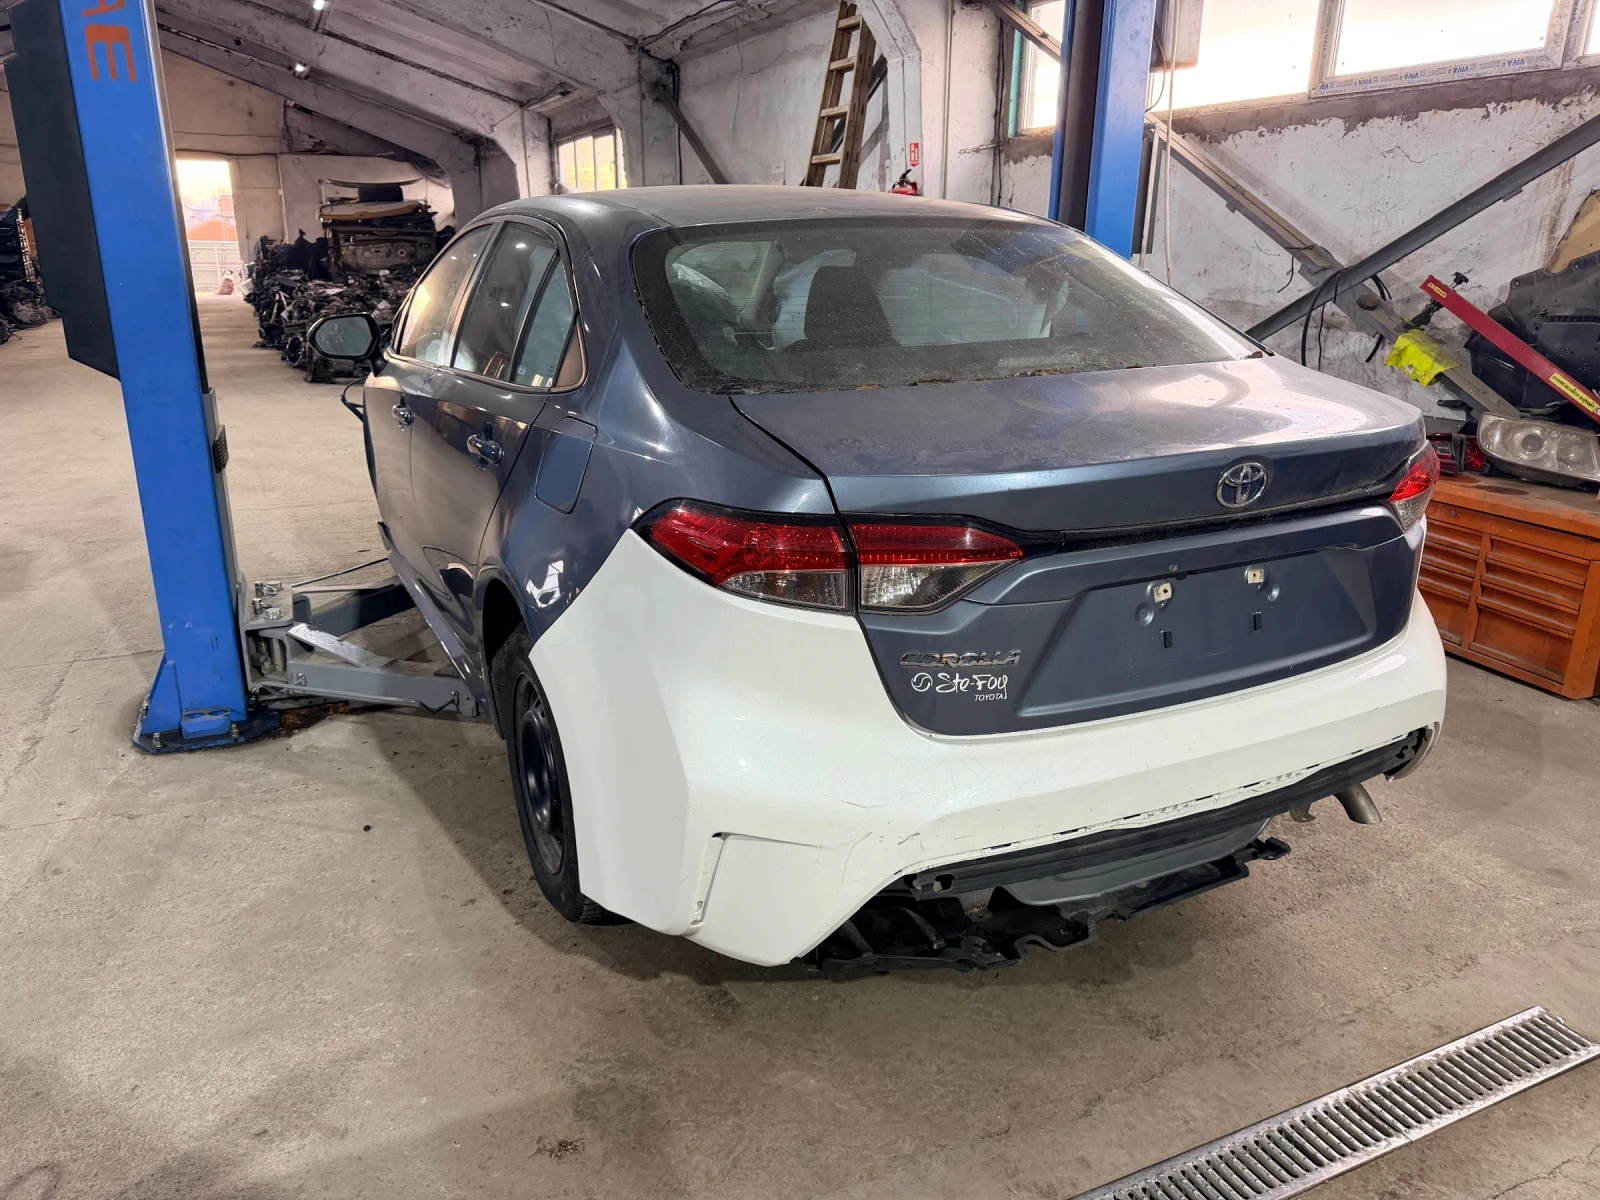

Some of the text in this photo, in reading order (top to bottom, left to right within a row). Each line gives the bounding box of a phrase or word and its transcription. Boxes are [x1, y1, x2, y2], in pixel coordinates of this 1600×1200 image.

[1507, 58, 1525, 66] VIVA
[1453, 65, 1469, 74] VIVA
[1404, 72, 1419, 80] VIVA
[899, 649, 1022, 668] COROLLA
[935, 672, 1008, 700] Ste-Foy
[974, 693, 1004, 702] TOYOTA
